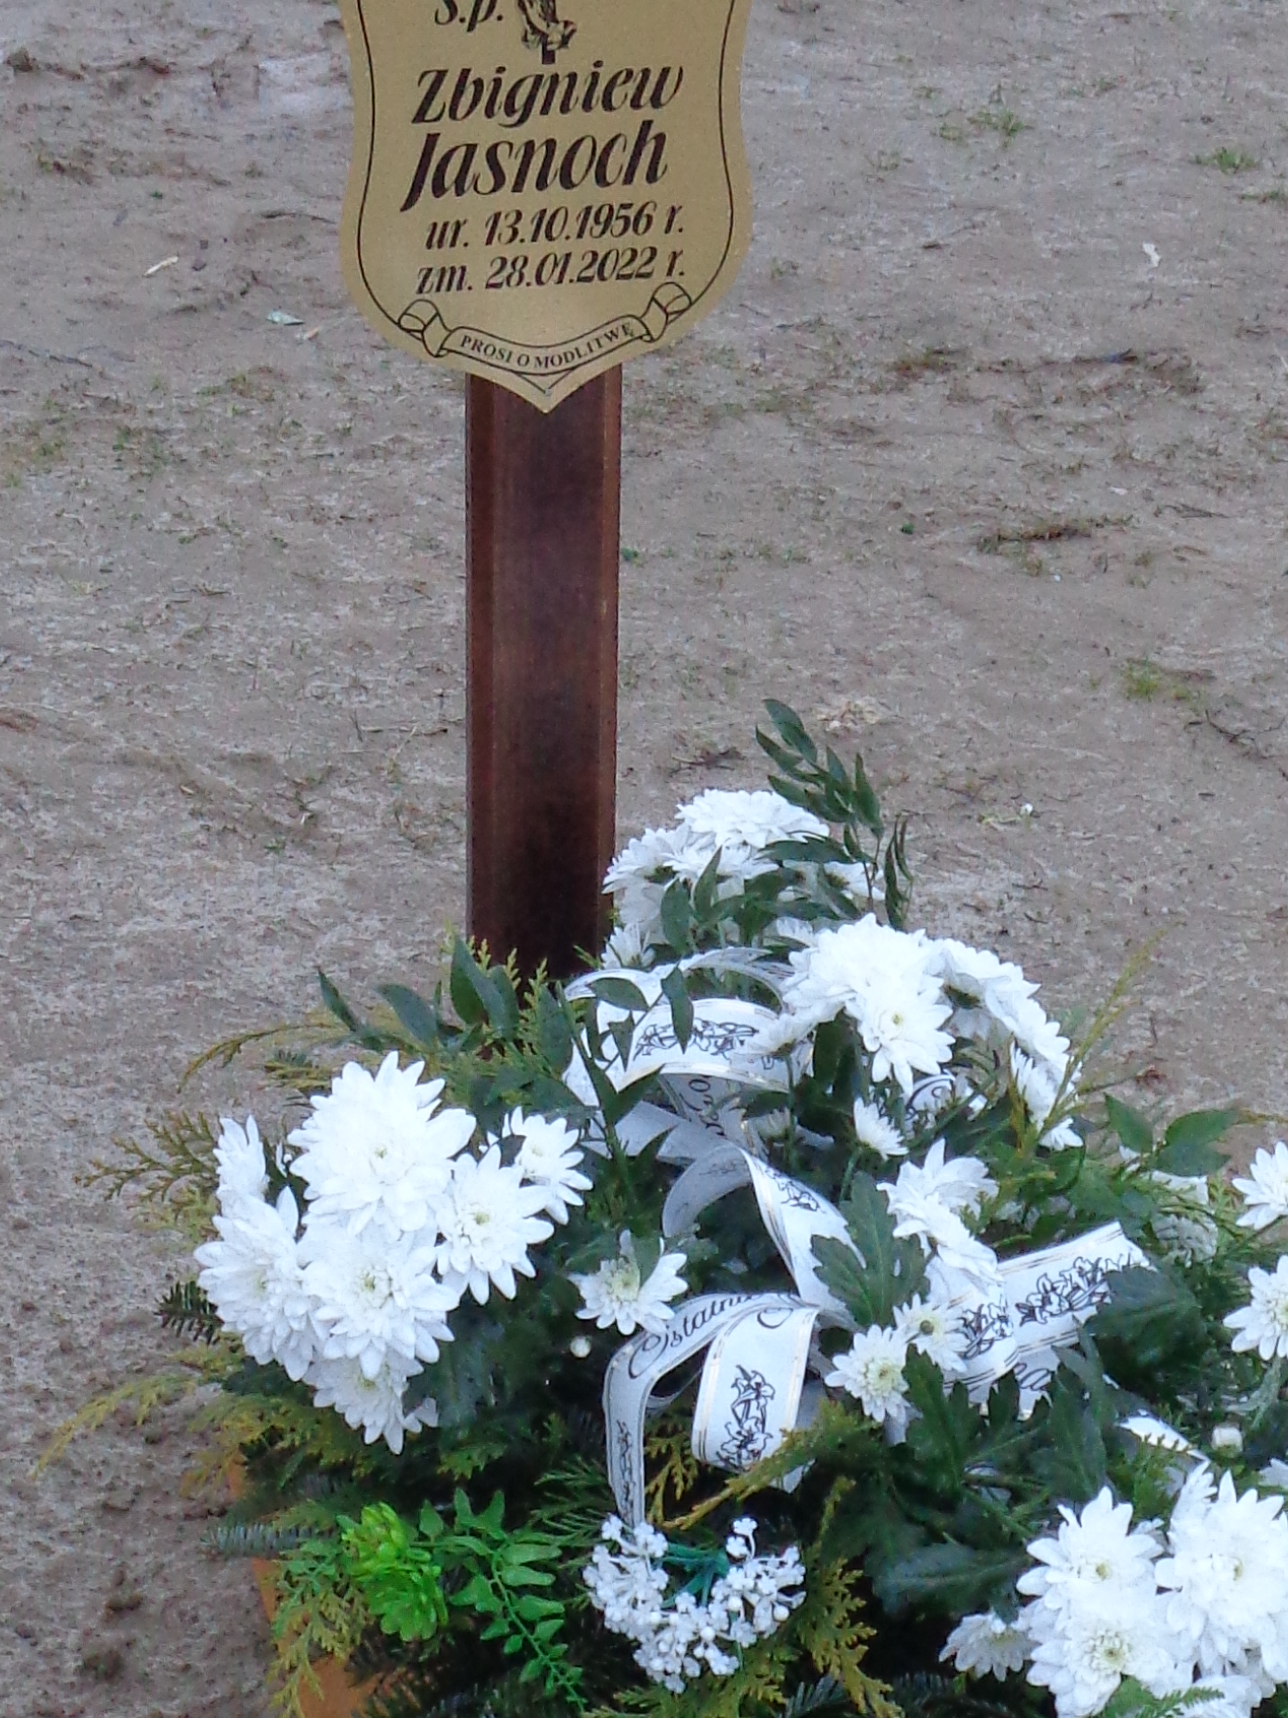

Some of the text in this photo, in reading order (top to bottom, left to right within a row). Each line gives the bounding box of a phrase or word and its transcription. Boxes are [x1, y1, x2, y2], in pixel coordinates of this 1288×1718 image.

[411, 60, 684, 129] Zbigniew
[399, 119, 669, 213] Jasnoch
[425, 201, 684, 250] ur. 13.10.1956 r.
[415, 246, 685, 295] zm. 28.01.2022 r.
[459, 334, 513, 363] PROSI
[516, 353, 531, 367] O
